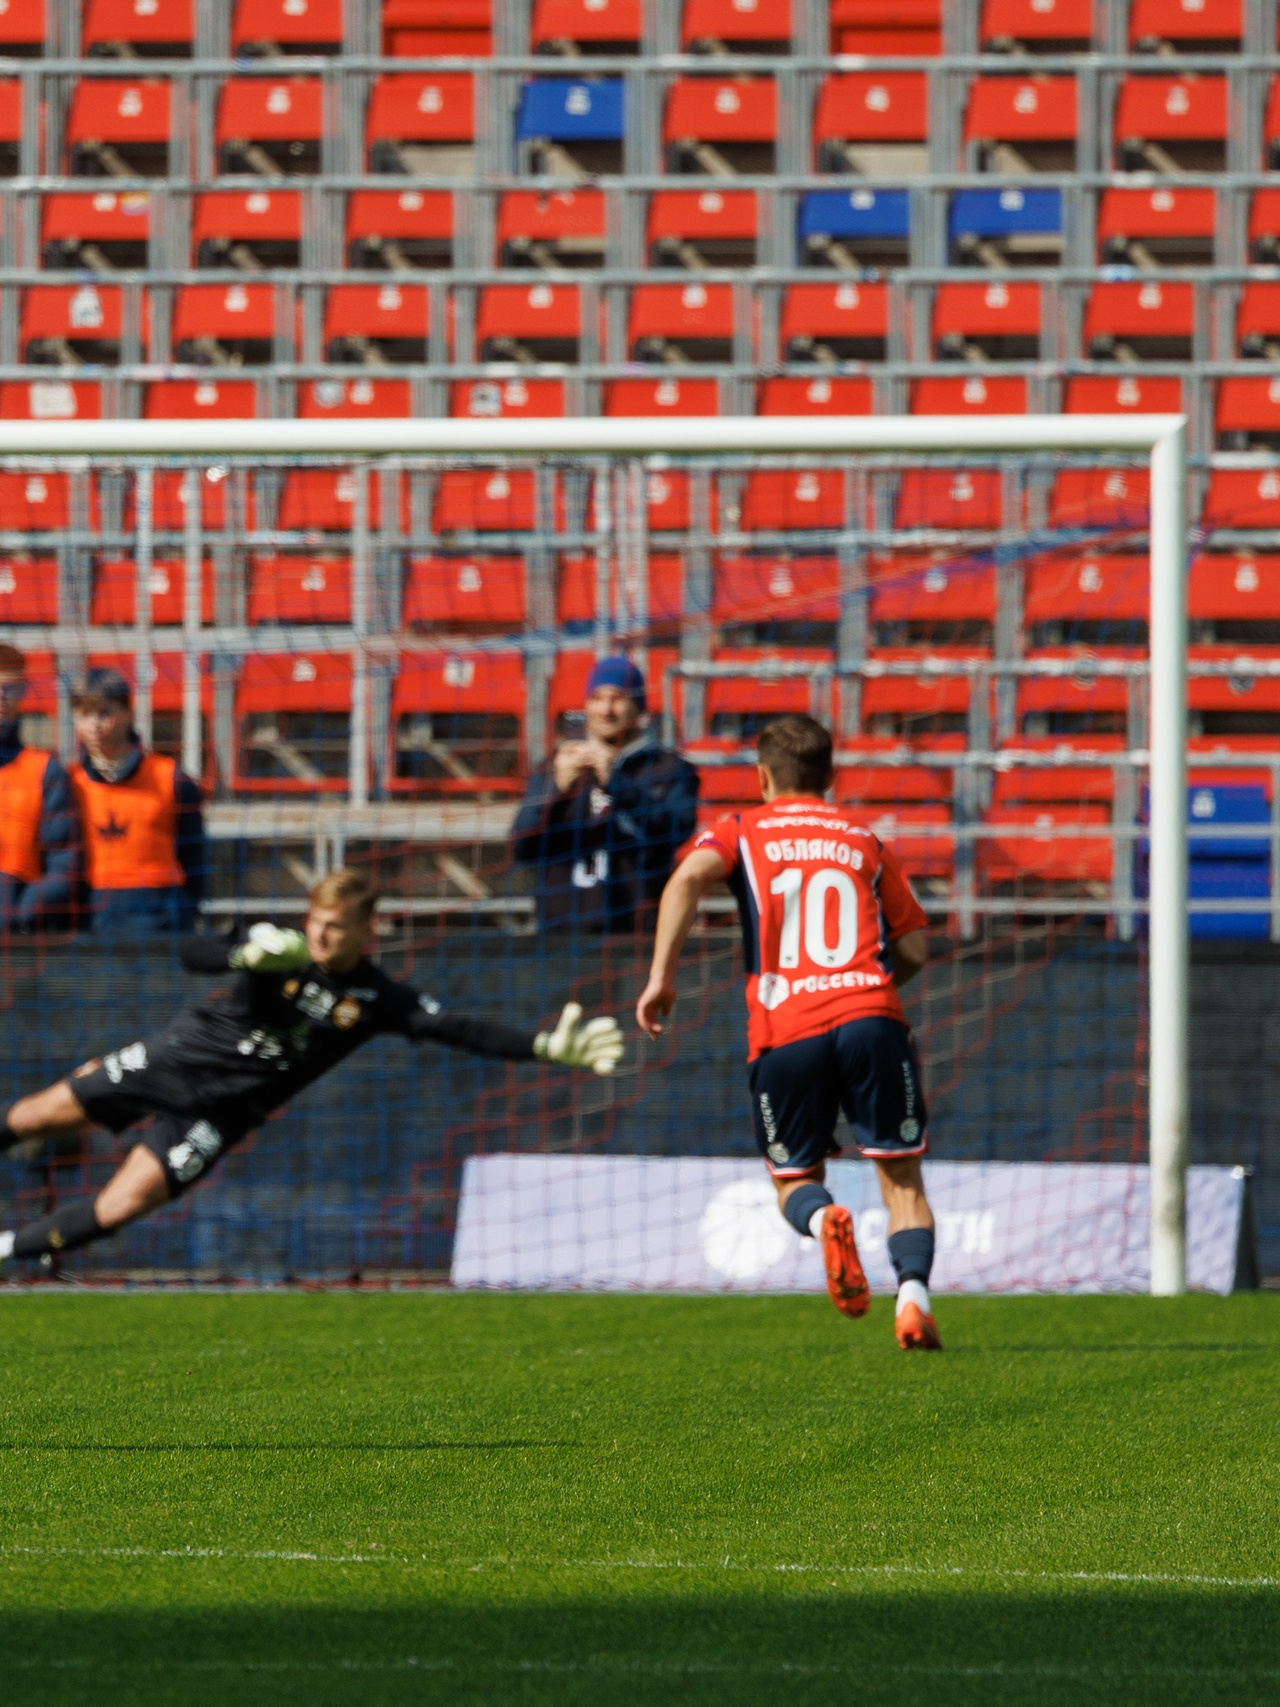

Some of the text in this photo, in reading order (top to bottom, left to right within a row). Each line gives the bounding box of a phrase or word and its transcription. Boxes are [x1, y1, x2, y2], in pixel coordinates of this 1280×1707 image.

[764, 838, 864, 871] ОБЛЯКОВ
[770, 868, 858, 968] 10
[792, 971, 881, 995] РОССЕТИ
